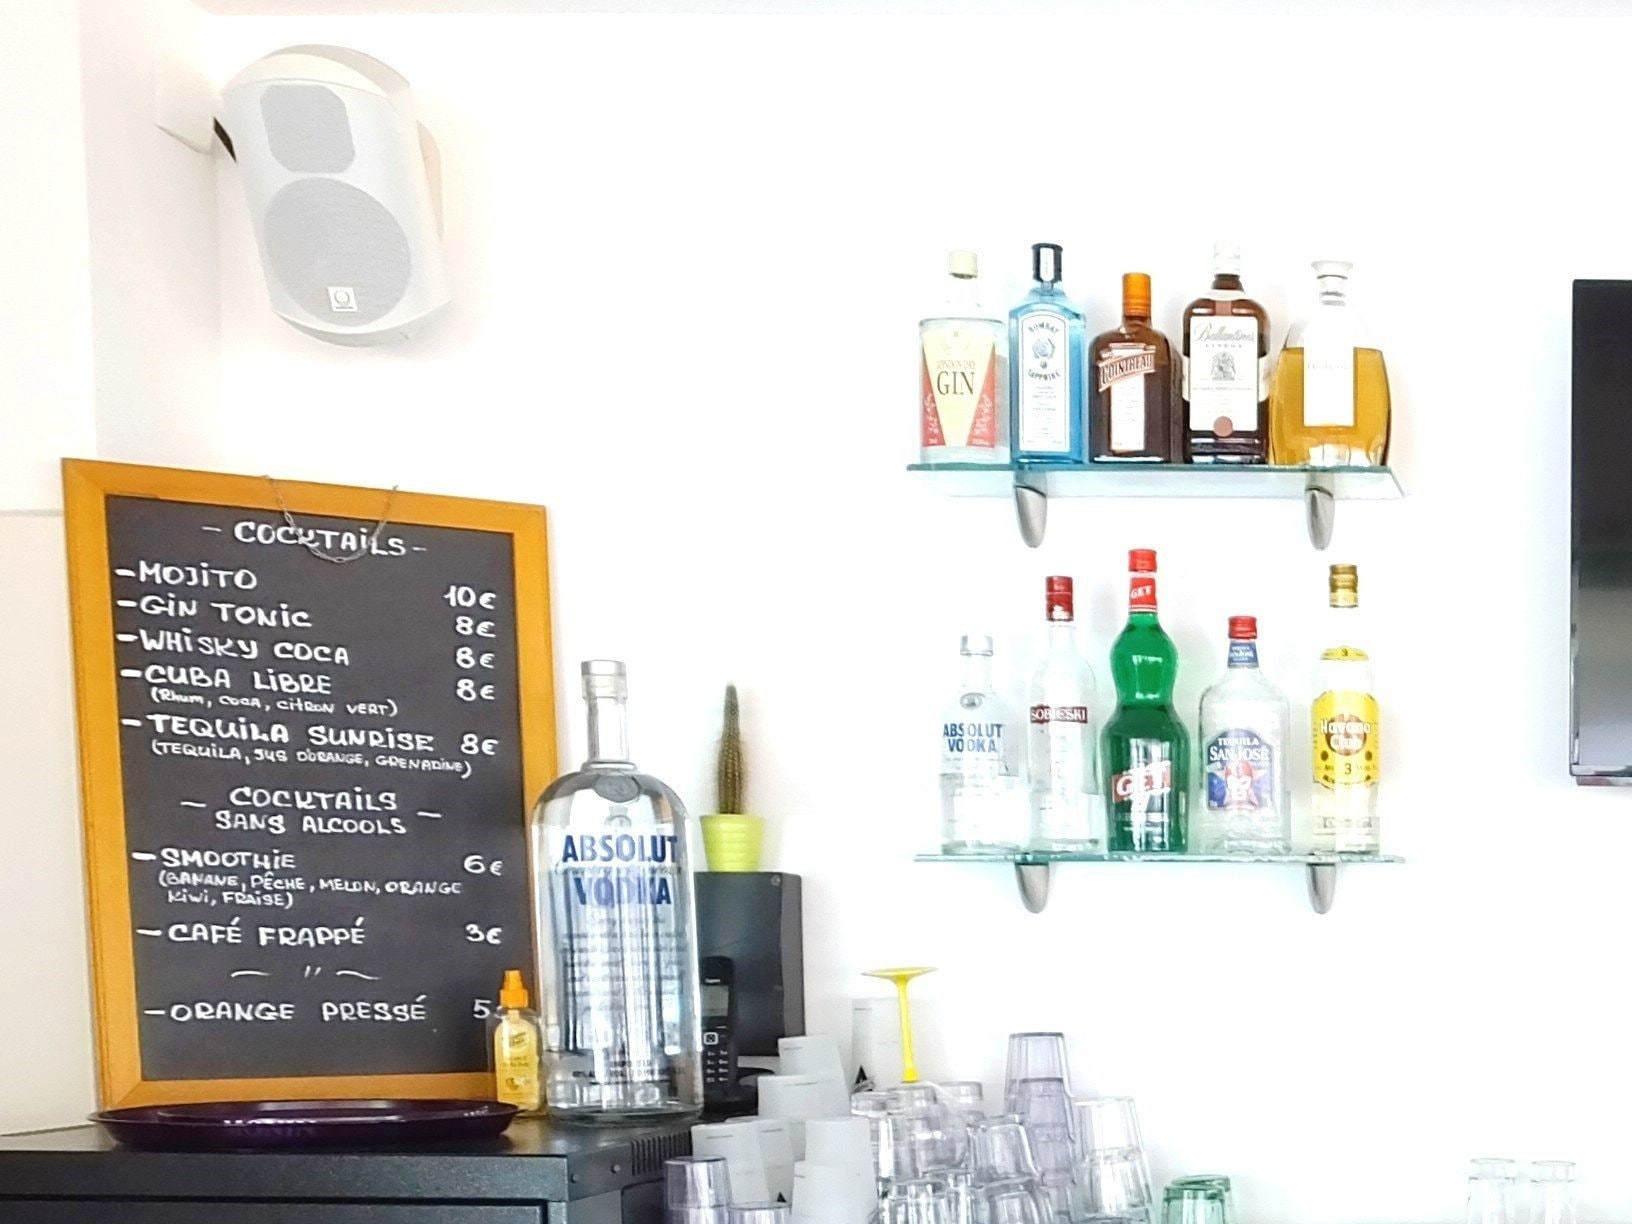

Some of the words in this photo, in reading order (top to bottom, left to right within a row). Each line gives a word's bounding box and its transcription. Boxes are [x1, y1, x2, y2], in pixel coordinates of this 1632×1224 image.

[936, 370, 976, 396] GIN
[234, 520, 407, 557] COCKTAILS
[211, 602, 313, 629] TONIC
[273, 643, 351, 667] COCA
[253, 668, 332, 697] LIBRE
[308, 723, 435, 752] SUNRISE
[942, 722, 1003, 740] ABSOLUT
[229, 785, 398, 812] COCKTAILS
[214, 809, 287, 835] SANS
[301, 814, 408, 836] ALCOOLS
[561, 833, 680, 864] ABSOLUT
[384, 880, 463, 896] ORANGE
[258, 916, 366, 946] FRAPPÉ
[321, 994, 429, 1022] PRESSÉ
